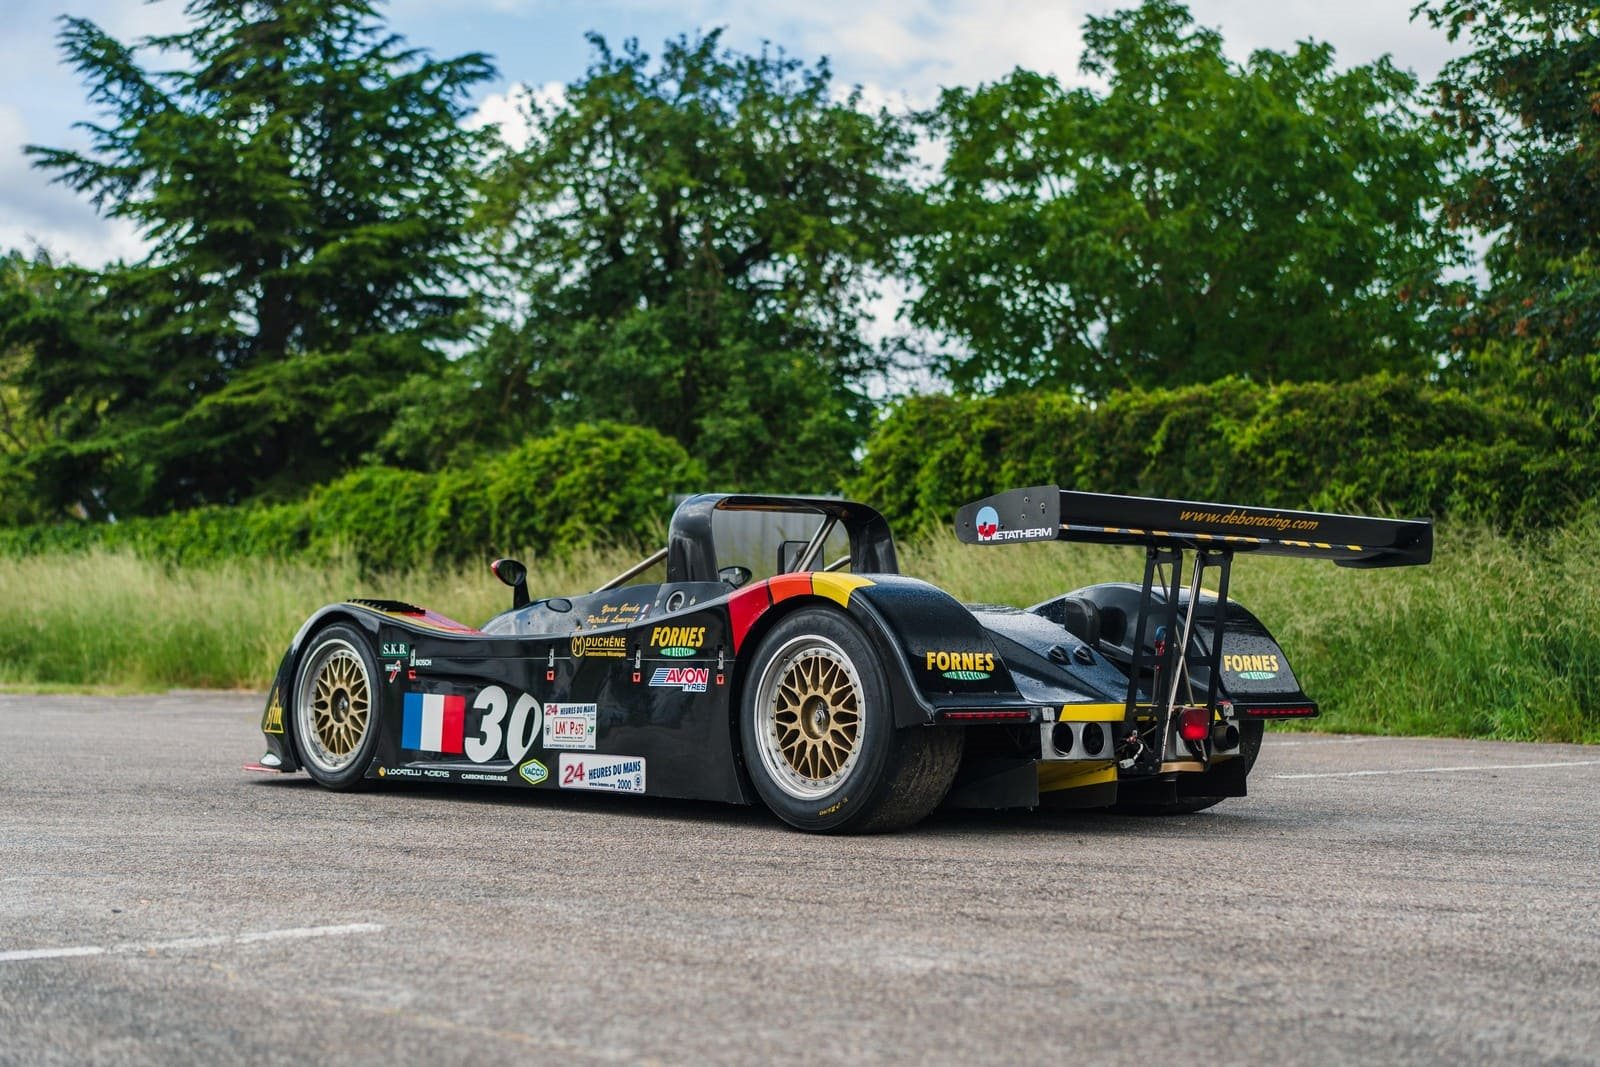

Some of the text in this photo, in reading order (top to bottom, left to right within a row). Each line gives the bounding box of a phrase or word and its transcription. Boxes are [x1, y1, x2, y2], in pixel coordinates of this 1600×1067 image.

[1179, 509, 1320, 531] www.deboracing.com
[585, 635, 627, 648] DUCHÊNE
[650, 626, 706, 647] FORNES
[926, 651, 995, 671] FORNES
[1223, 654, 1279, 672] FORNES
[665, 668, 709, 684] AVON
[683, 683, 706, 691] TYRES
[545, 704, 558, 716] 24
[464, 685, 543, 766] 30
[523, 767, 545, 777] YACCO
[563, 761, 641, 785] 24 HEURES DU MANS
[617, 779, 632, 790] 2000
